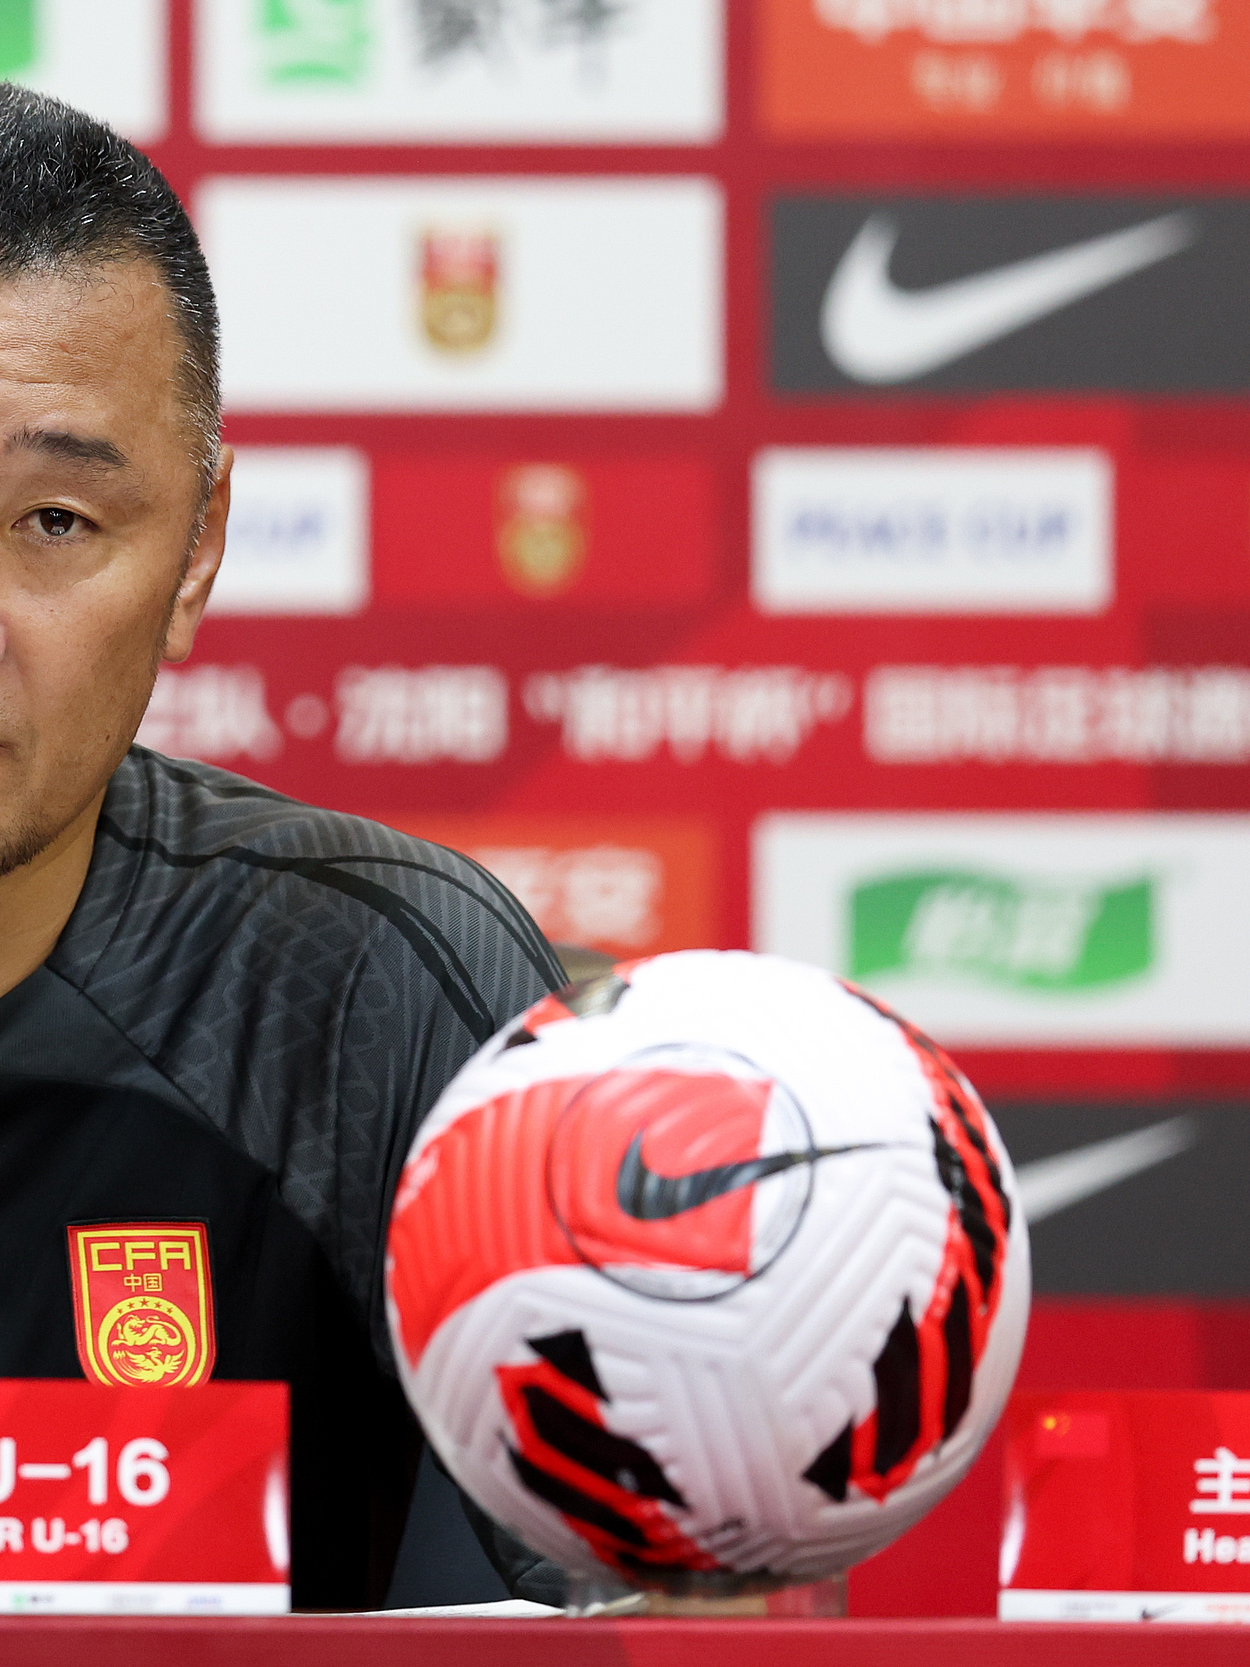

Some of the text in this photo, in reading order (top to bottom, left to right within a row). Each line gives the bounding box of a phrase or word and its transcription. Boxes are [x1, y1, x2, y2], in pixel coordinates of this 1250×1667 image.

[90, 1241, 192, 1272] CFA
[123, 1273, 163, 1293] 中国
[32, 1517, 129, 1553] U-16
